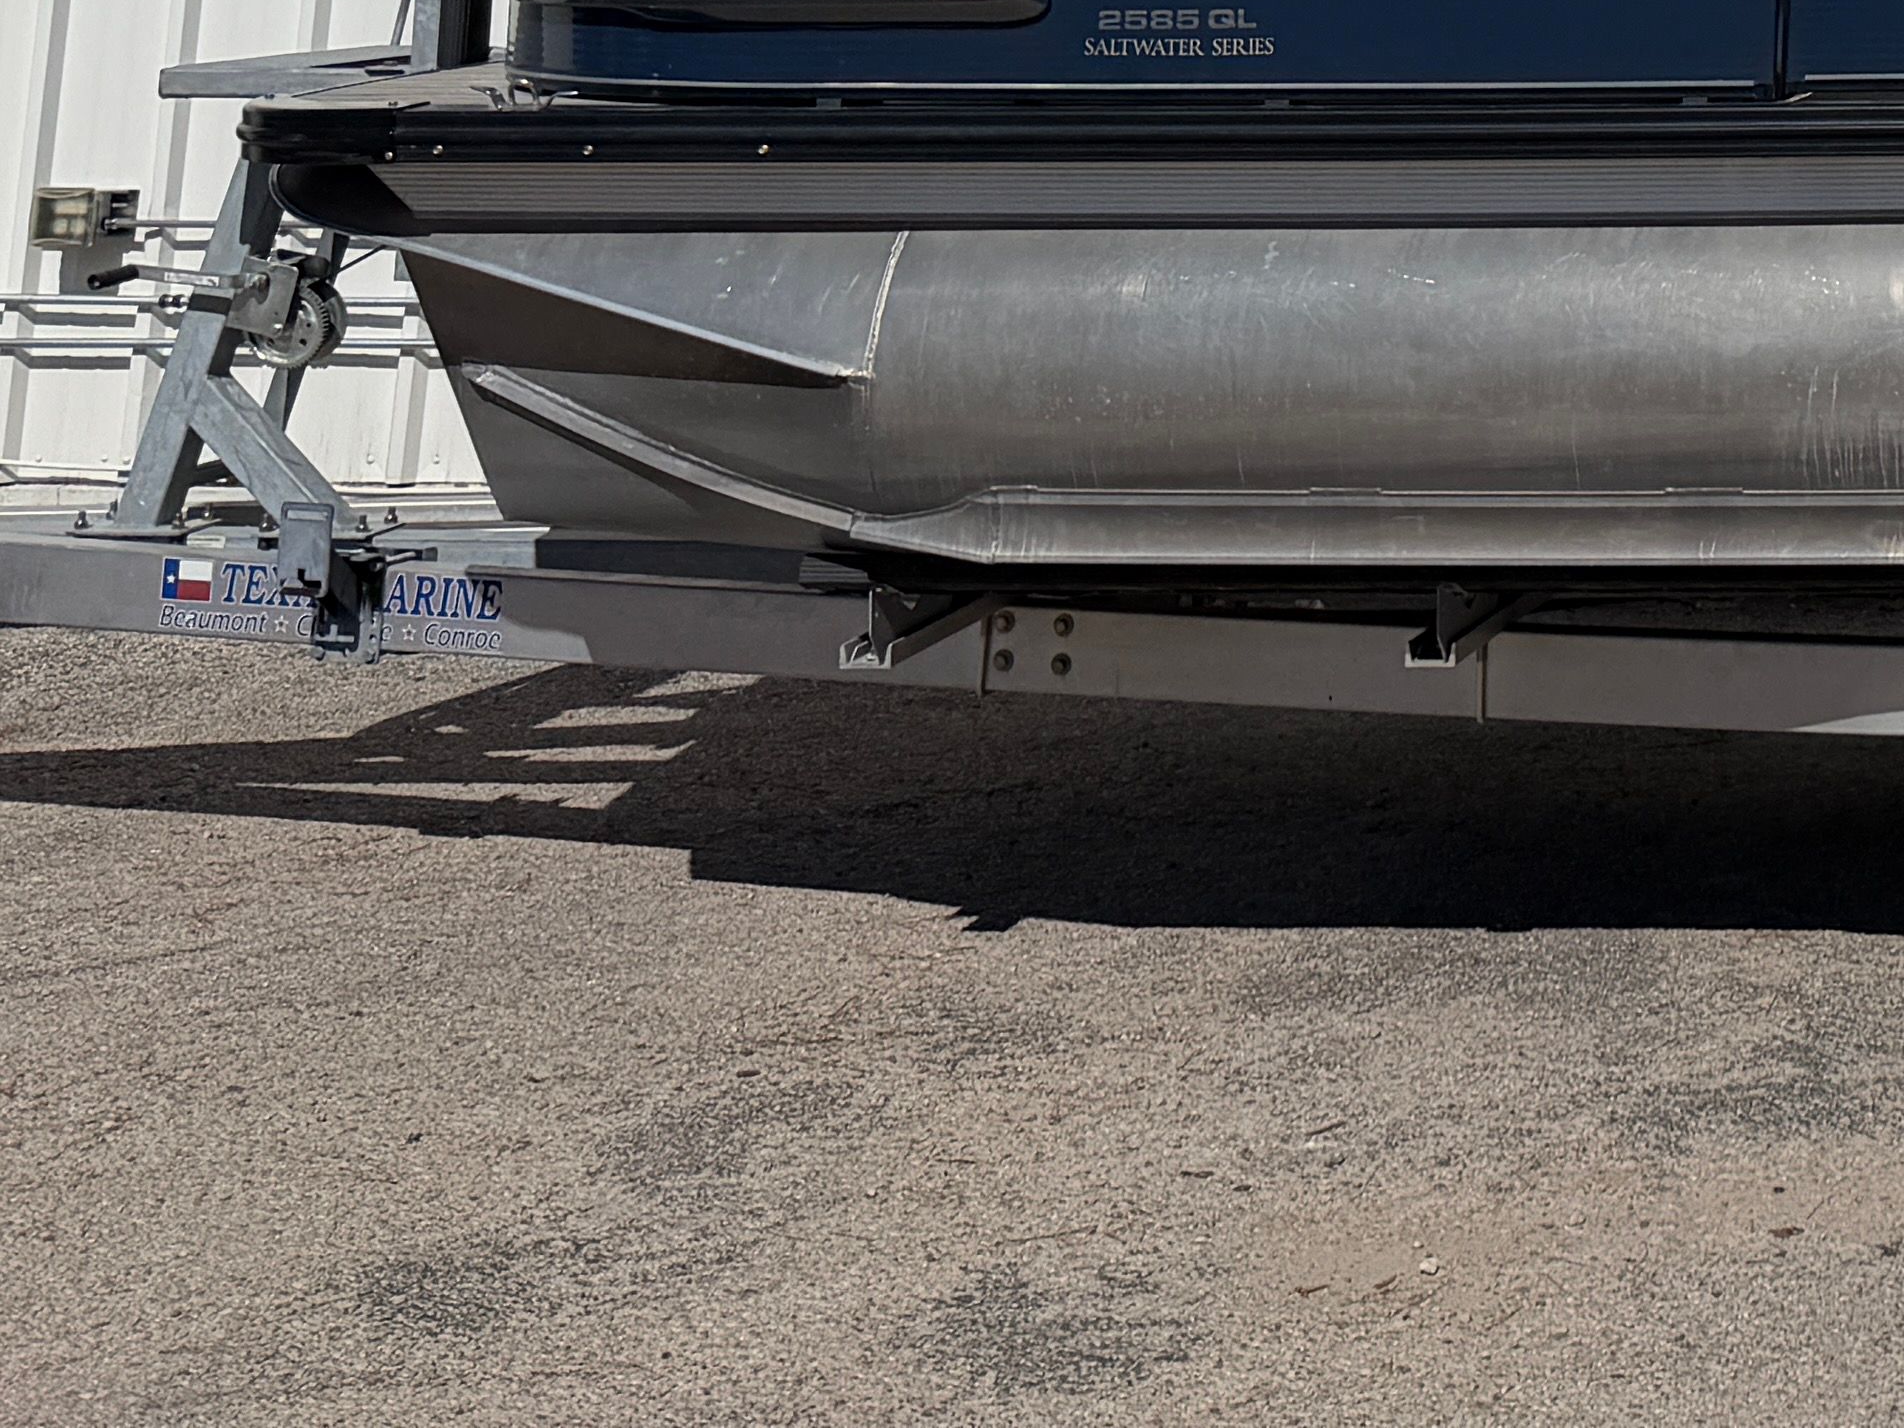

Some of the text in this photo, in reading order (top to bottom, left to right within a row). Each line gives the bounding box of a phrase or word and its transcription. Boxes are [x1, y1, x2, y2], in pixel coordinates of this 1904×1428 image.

[1098, 9, 1200, 30] 2585
[1084, 37, 1274, 56] SALTWATER SERIES
[382, 574, 503, 620] ARINE
[160, 605, 268, 632] Beaumont
[424, 623, 501, 649] Conroe
